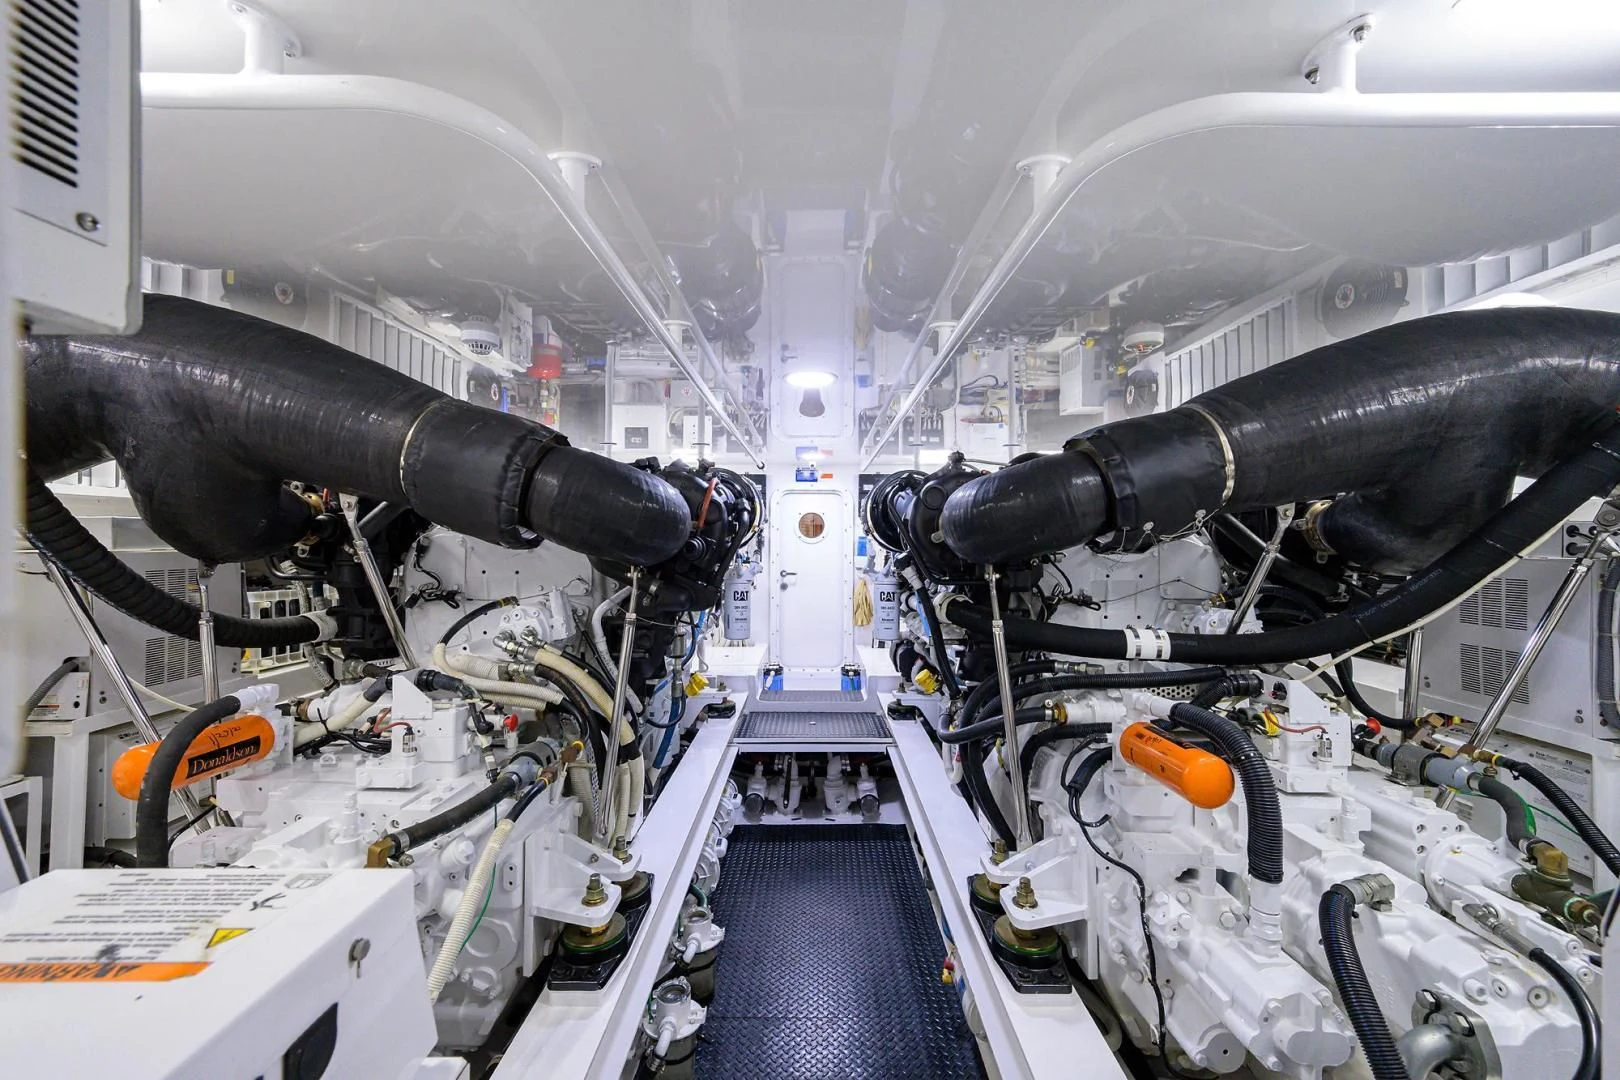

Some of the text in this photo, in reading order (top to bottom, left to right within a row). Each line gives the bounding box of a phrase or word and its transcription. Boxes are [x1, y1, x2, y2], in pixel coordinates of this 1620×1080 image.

[733, 590, 749, 602] CAT
[879, 591, 896, 602] CAT
[193, 745, 255, 774] Donaldson
